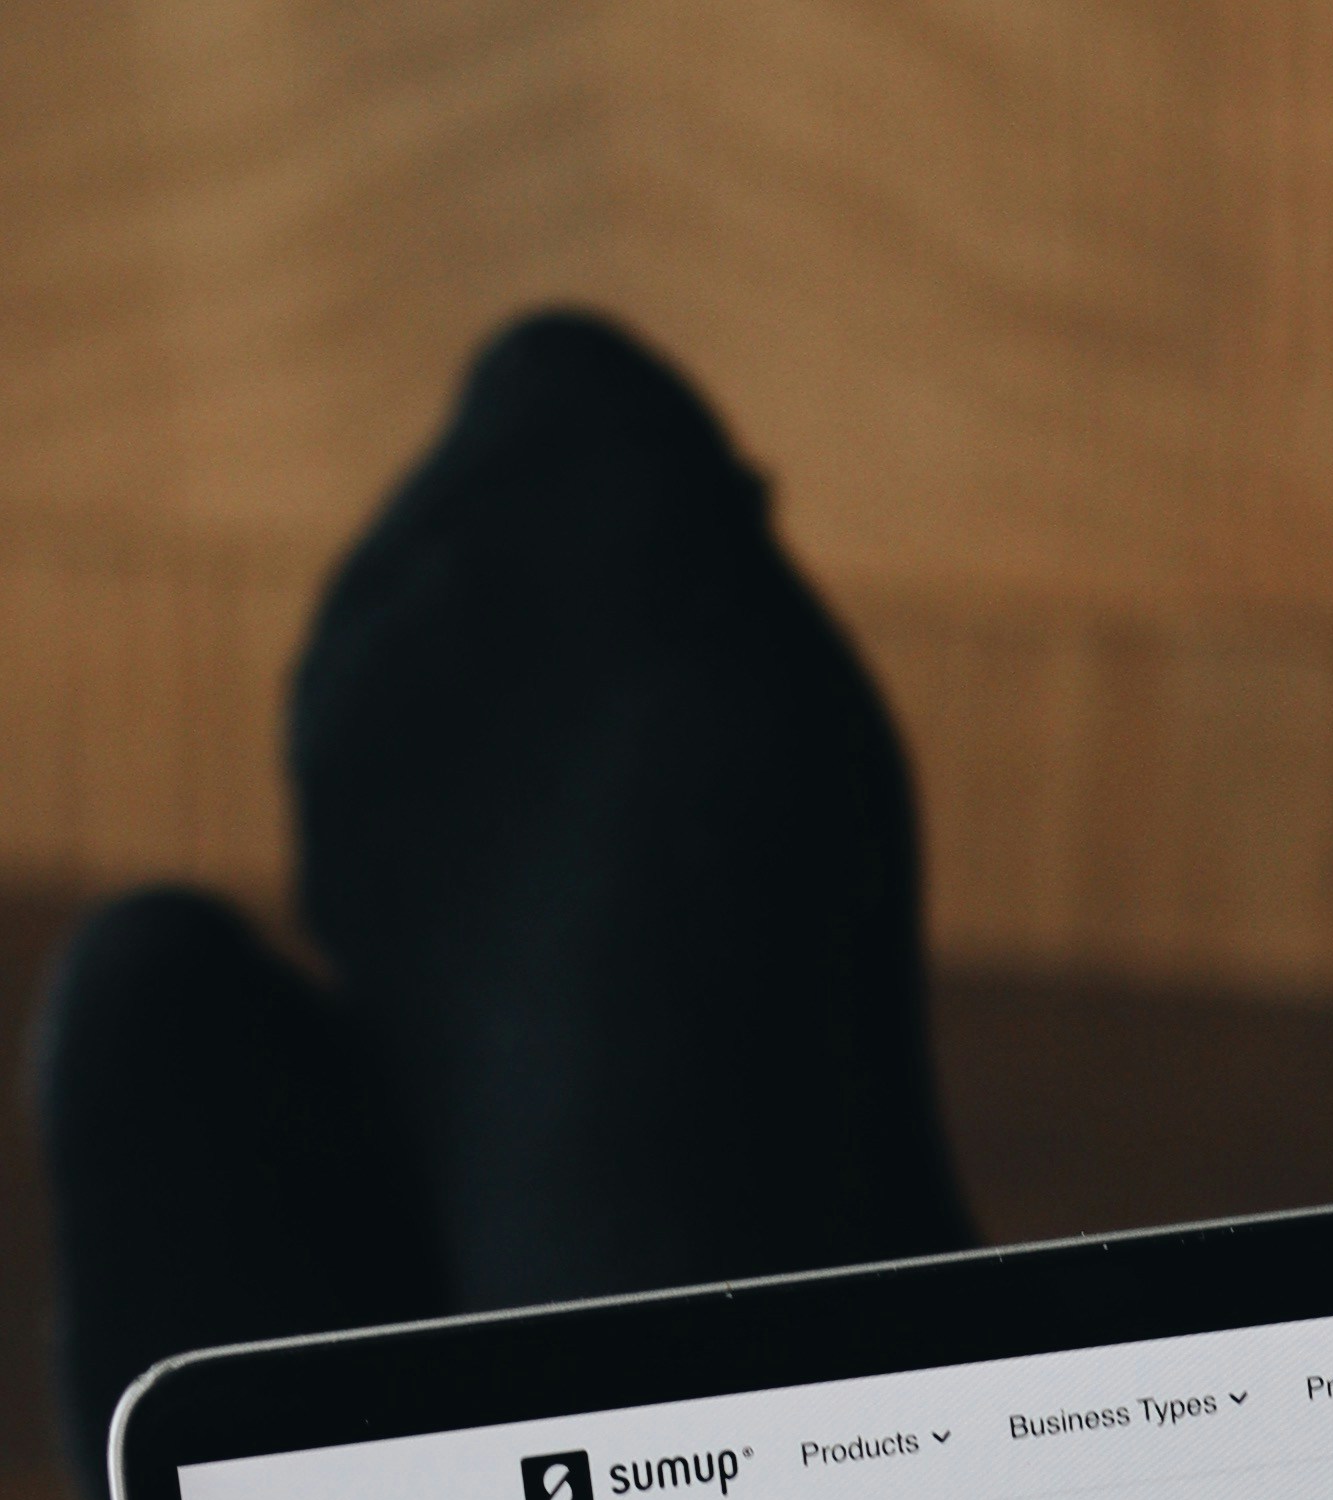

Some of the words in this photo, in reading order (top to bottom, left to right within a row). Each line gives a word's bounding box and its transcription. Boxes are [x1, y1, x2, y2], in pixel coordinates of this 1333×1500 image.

[1010, 1408, 1130, 1438] Business
[1141, 1397, 1217, 1425] Types
[802, 1433, 919, 1466] Products
